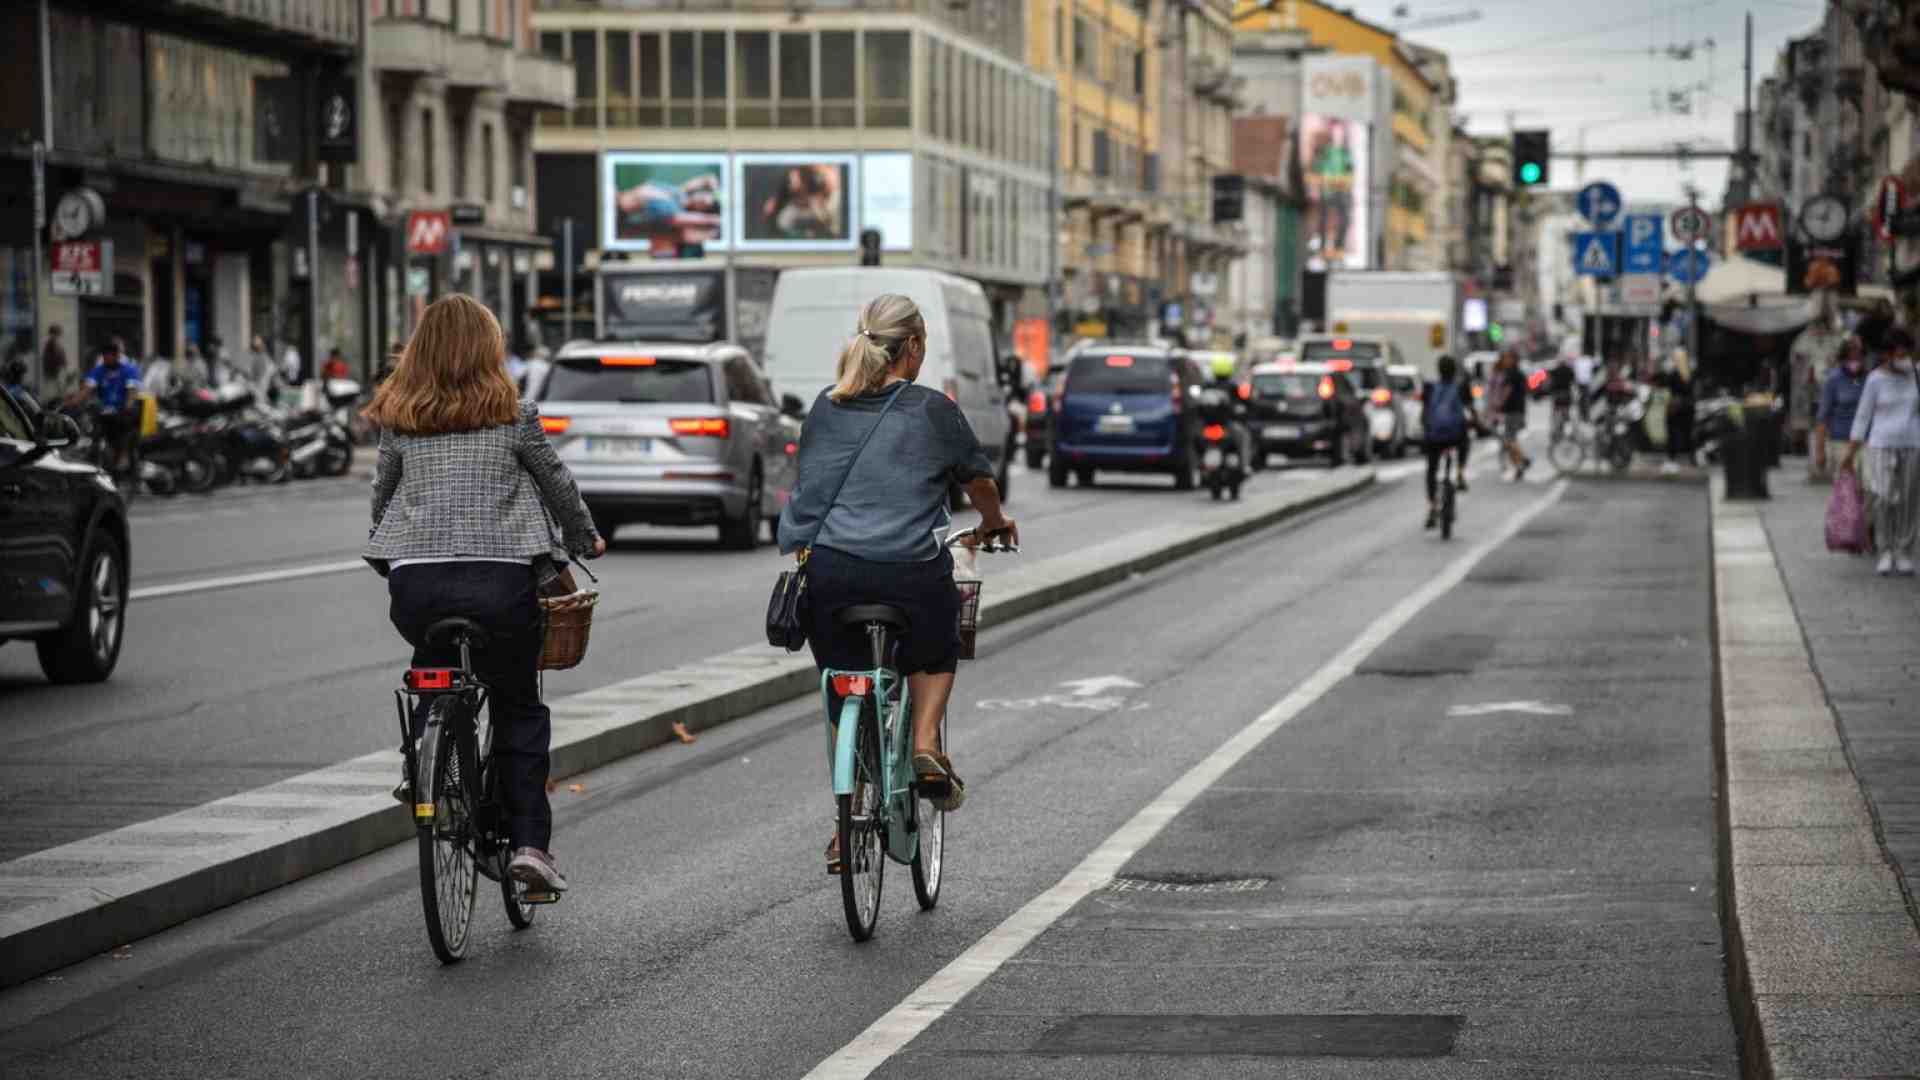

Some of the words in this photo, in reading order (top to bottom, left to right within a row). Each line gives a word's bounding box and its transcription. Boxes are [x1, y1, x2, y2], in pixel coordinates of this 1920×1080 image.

[414, 218, 444, 245] M
[1631, 219, 1654, 245] P
[1739, 212, 1777, 239] M
